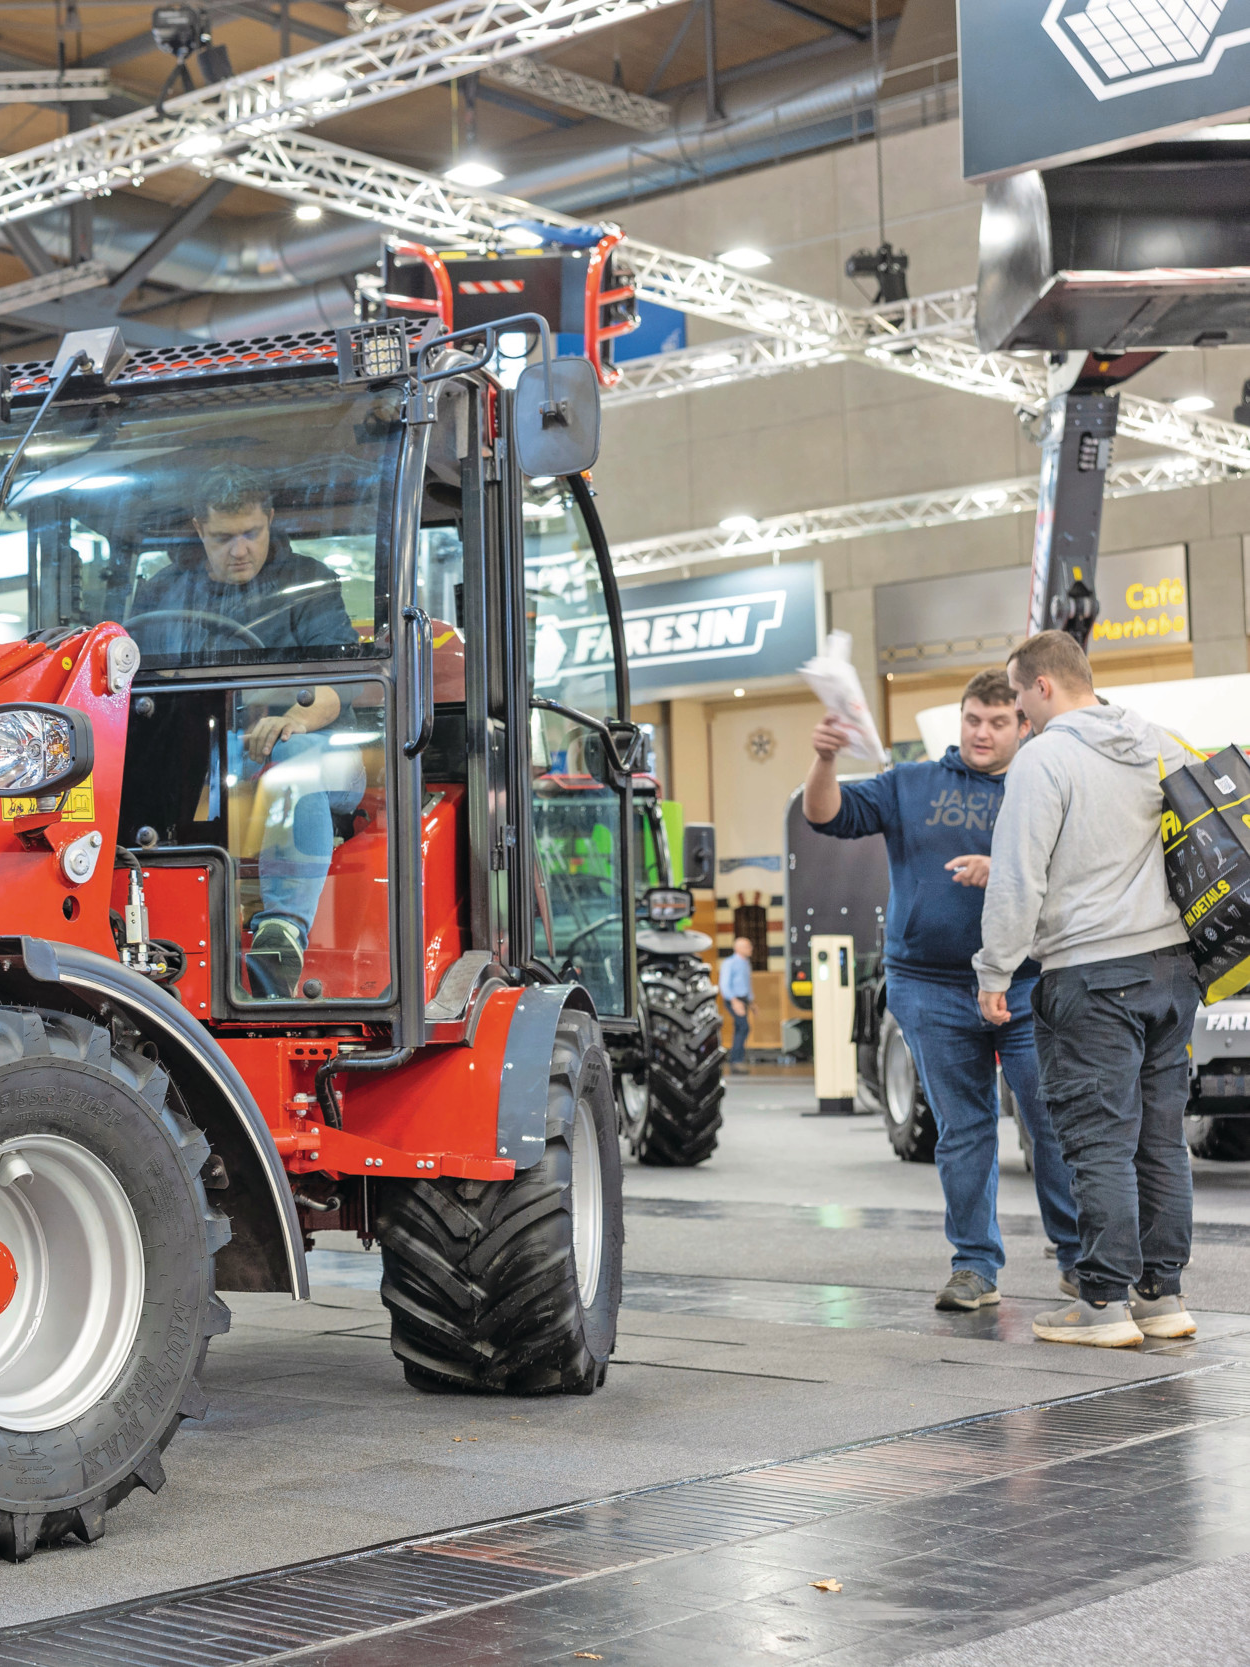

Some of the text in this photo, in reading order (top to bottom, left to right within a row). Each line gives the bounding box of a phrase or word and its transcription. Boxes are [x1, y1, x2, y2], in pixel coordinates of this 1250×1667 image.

[1125, 577, 1185, 610] Café
[573, 606, 751, 664] FARESIN
[1191, 879, 1230, 919] DETAILS
